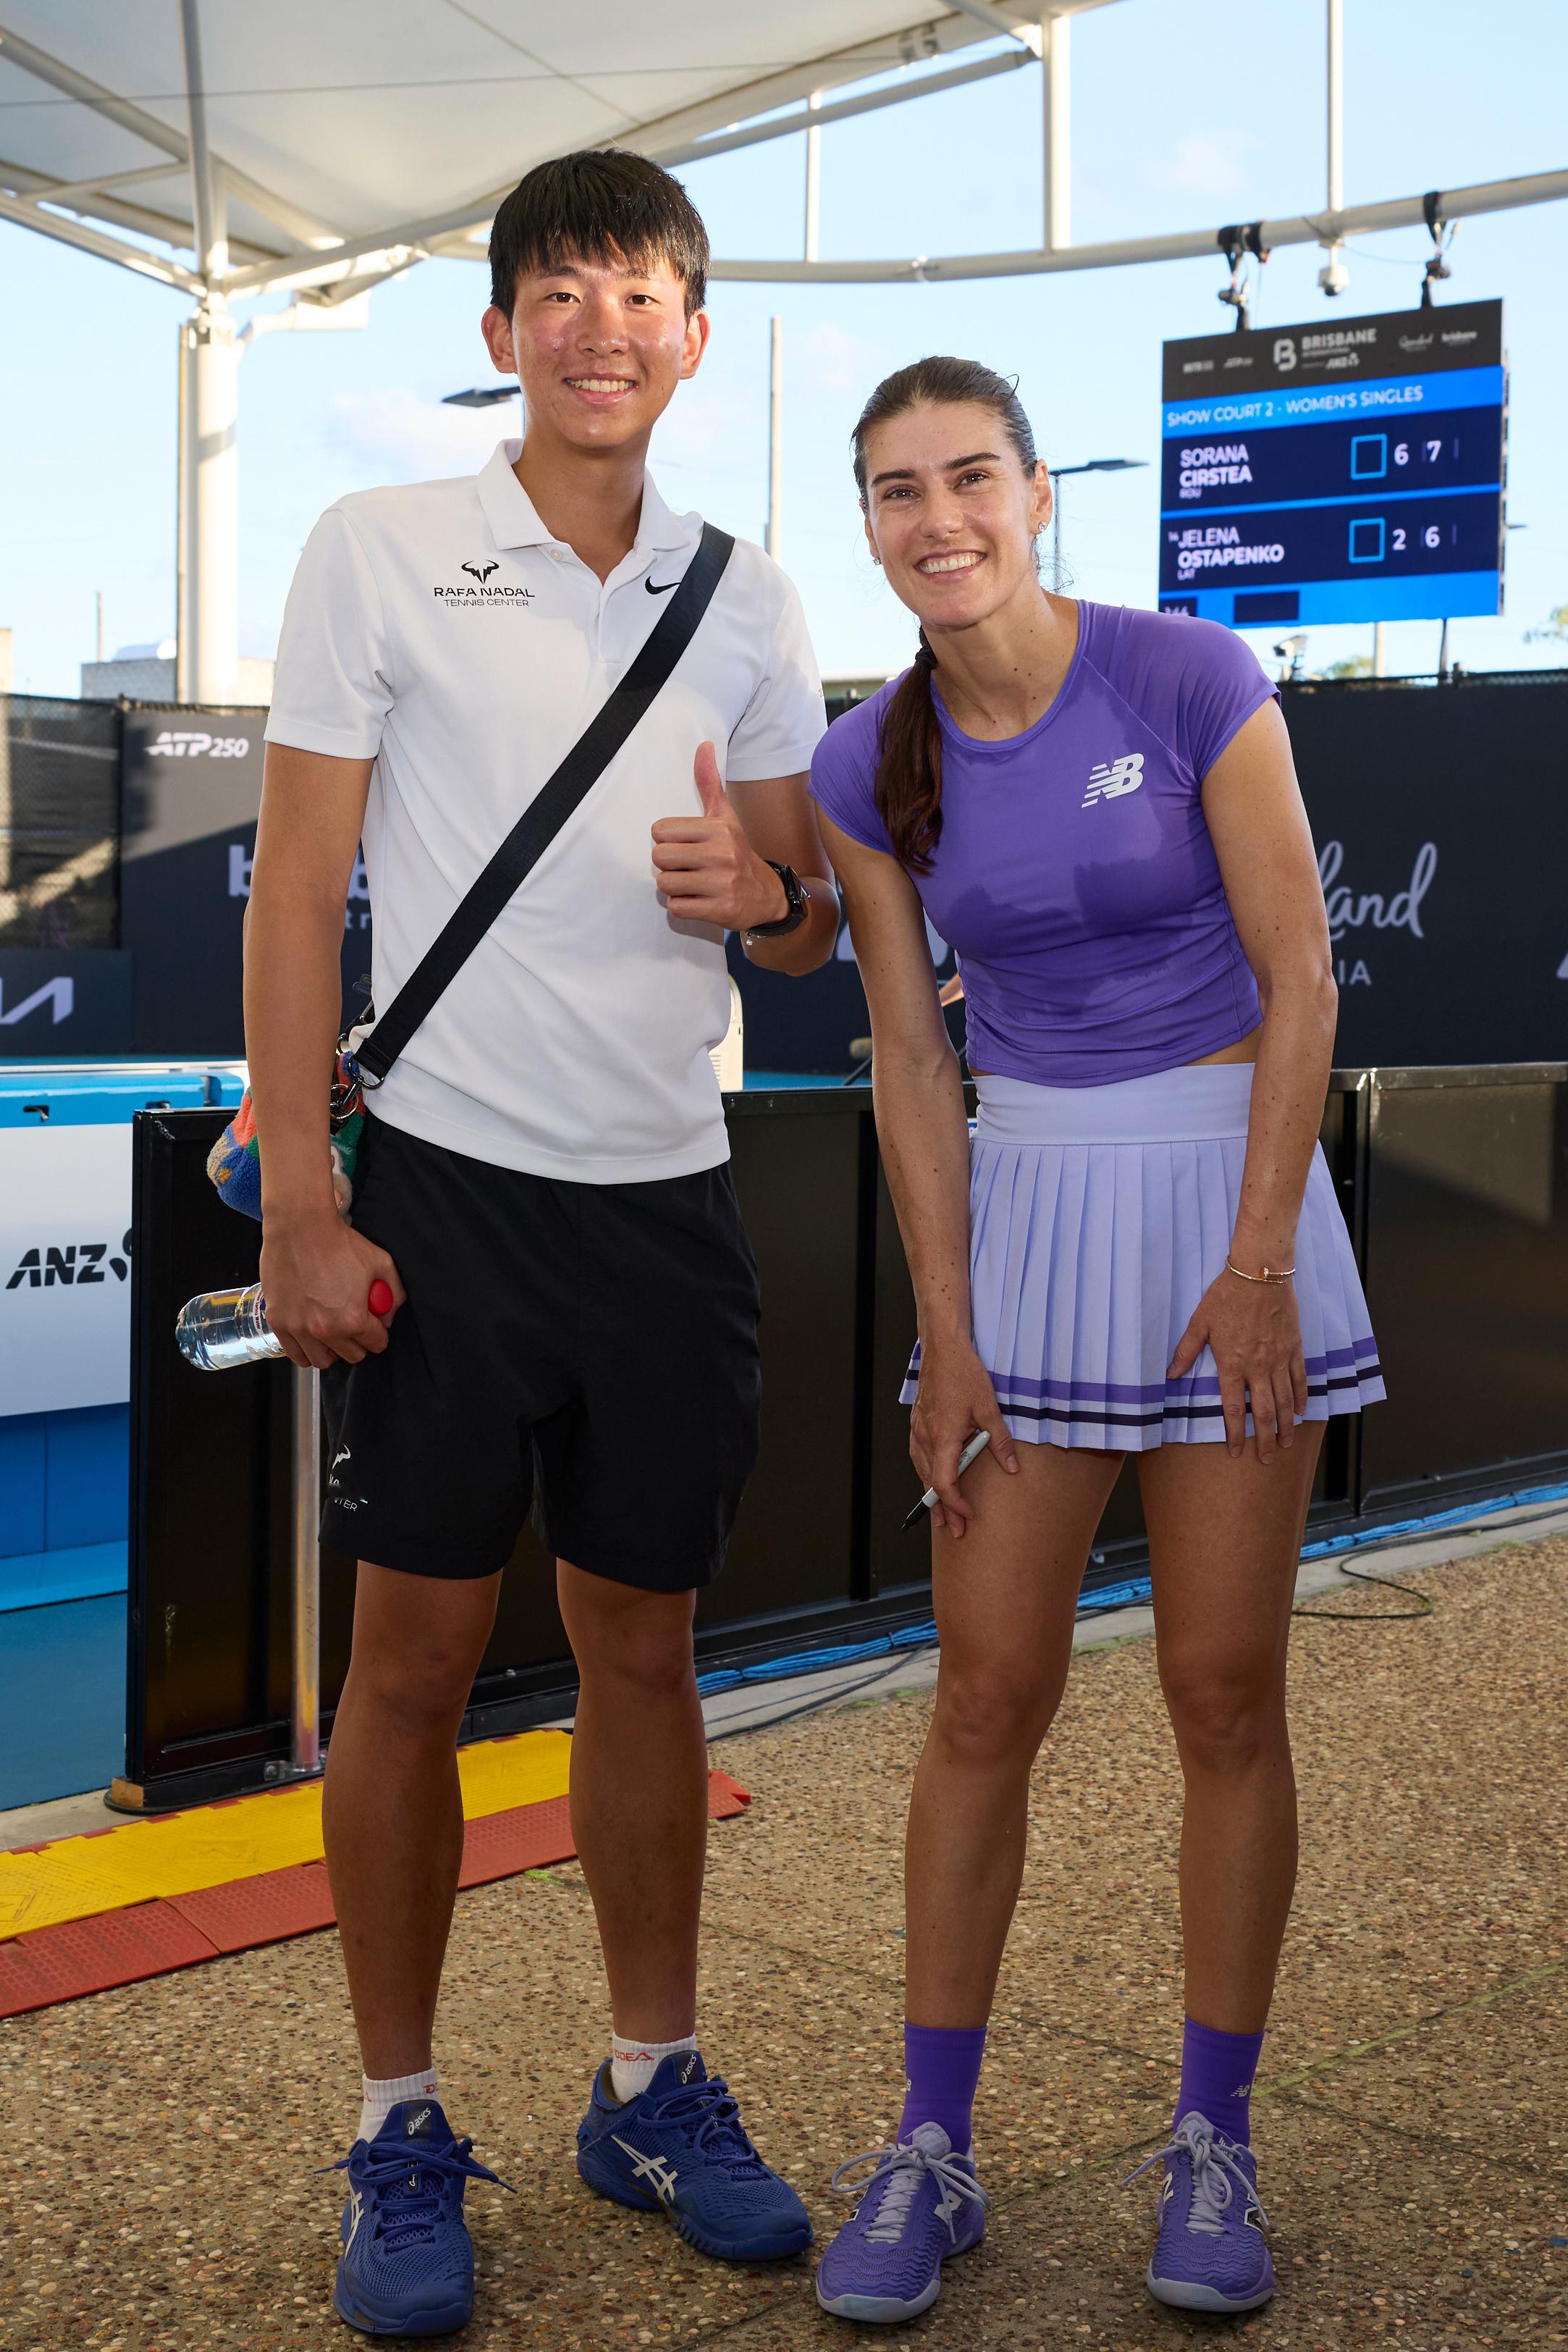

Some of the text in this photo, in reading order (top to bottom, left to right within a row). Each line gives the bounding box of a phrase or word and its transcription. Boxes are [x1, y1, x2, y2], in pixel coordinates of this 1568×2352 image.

[1301, 328, 1377, 350] BRISBANE
[1167, 410, 1210, 427] SHOW
[1213, 403, 1262, 422] COURT
[1265, 402, 1274, 417] 2
[1286, 393, 1357, 414] WOMEN'S
[1360, 385, 1424, 406] SINGLES
[1180, 443, 1249, 468] SORANA
[1394, 440, 1442, 465] 6 7
[1179, 465, 1253, 488] CIRSTEA
[1179, 487, 1202, 499] ROU
[1178, 526, 1240, 549] JELENA
[1392, 526, 1441, 550] 2 6
[1177, 544, 1285, 569] OSTAPENKO
[434, 587, 536, 597] RAFA NADAL
[486, 598, 530, 607] CENTER
[1081, 752, 1145, 809] NB
[5, 1243, 108, 1290] ANZ
[683, 2054, 697, 2078] asics
[411, 2107, 432, 2132] asics
